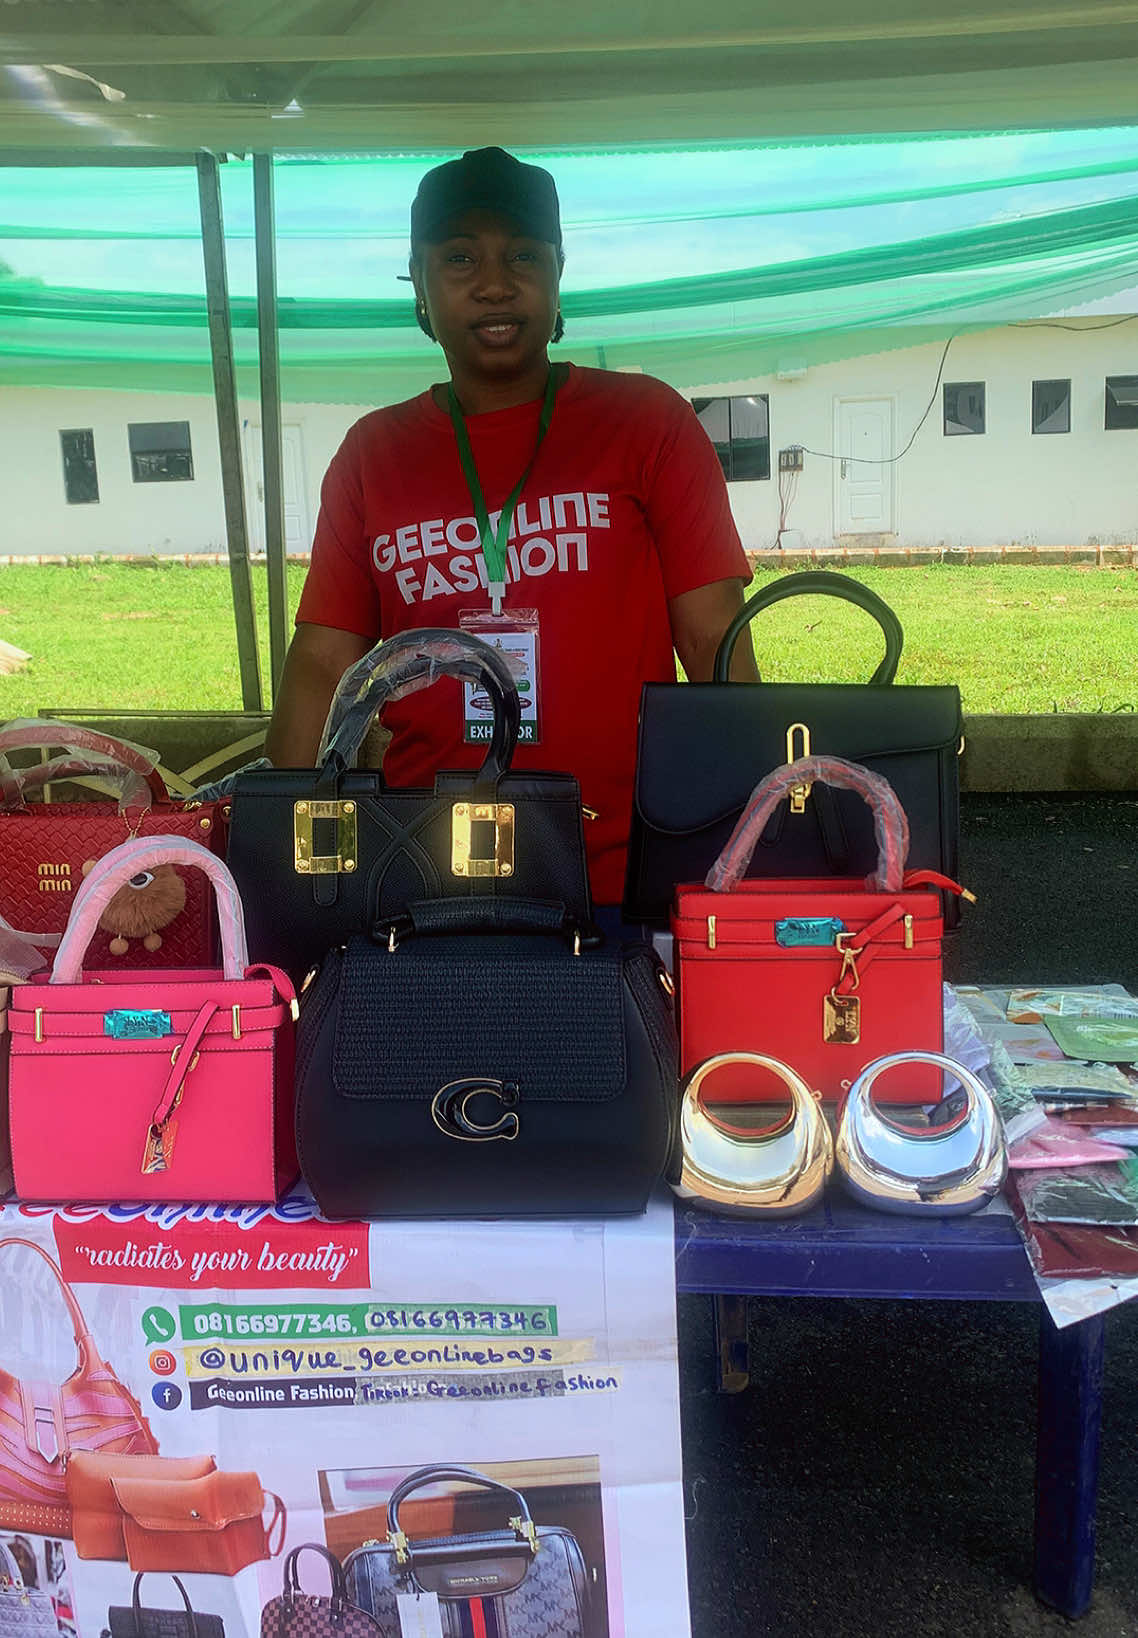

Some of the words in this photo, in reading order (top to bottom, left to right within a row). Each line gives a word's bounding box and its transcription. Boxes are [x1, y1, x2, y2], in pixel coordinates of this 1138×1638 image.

[470, 725, 533, 738] EXHOR
[190, 1249, 251, 1281] your
[193, 1312, 358, 1335] 08166977346,
[370, 1309, 547, 1331] 08166977346
[207, 1383, 286, 1401] Geeonline
[290, 1385, 356, 1401] Fashion
